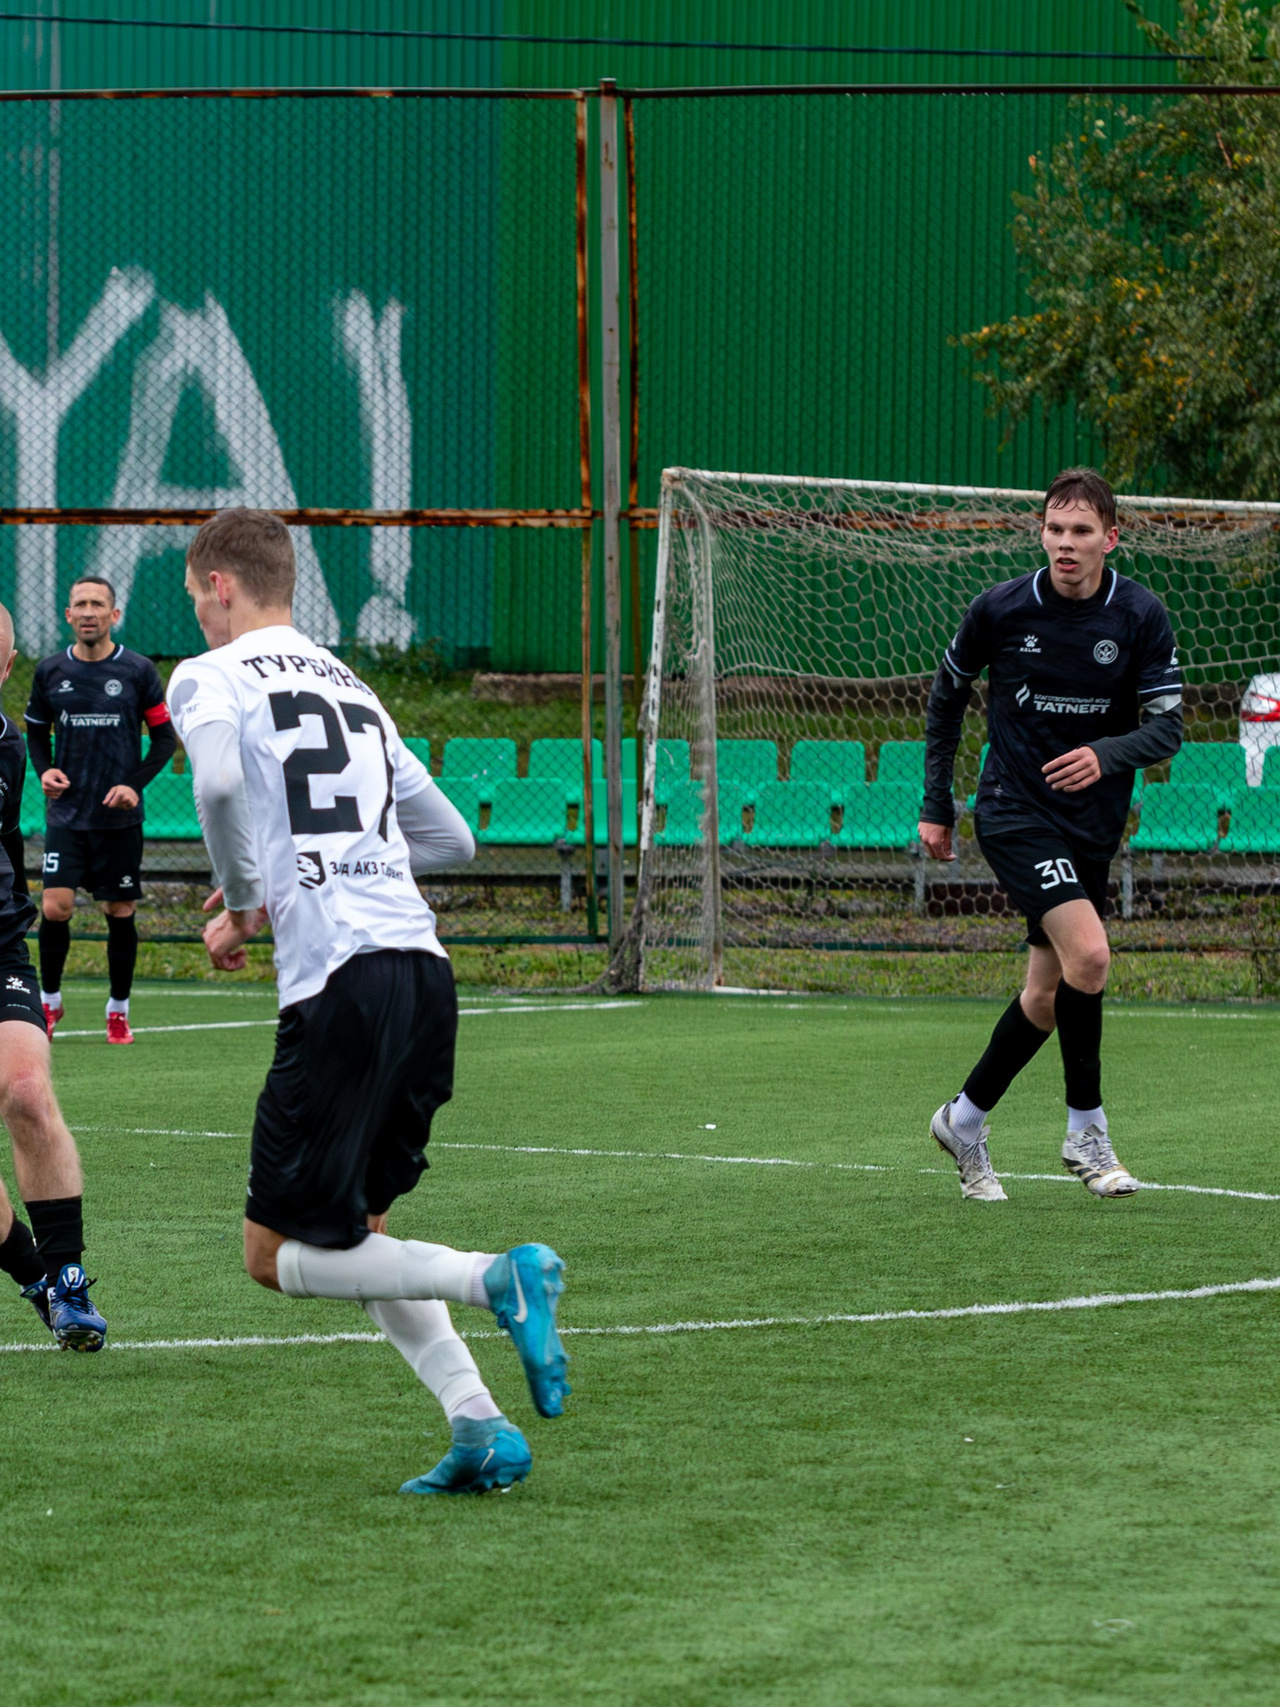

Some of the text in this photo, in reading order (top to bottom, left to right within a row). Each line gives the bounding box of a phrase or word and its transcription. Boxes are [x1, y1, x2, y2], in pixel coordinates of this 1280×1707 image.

[1033, 700, 1110, 714] TATNEFT
[70, 718, 120, 727] TATNEFT
[267, 690, 394, 843] 27
[1033, 857, 1079, 890] 30
